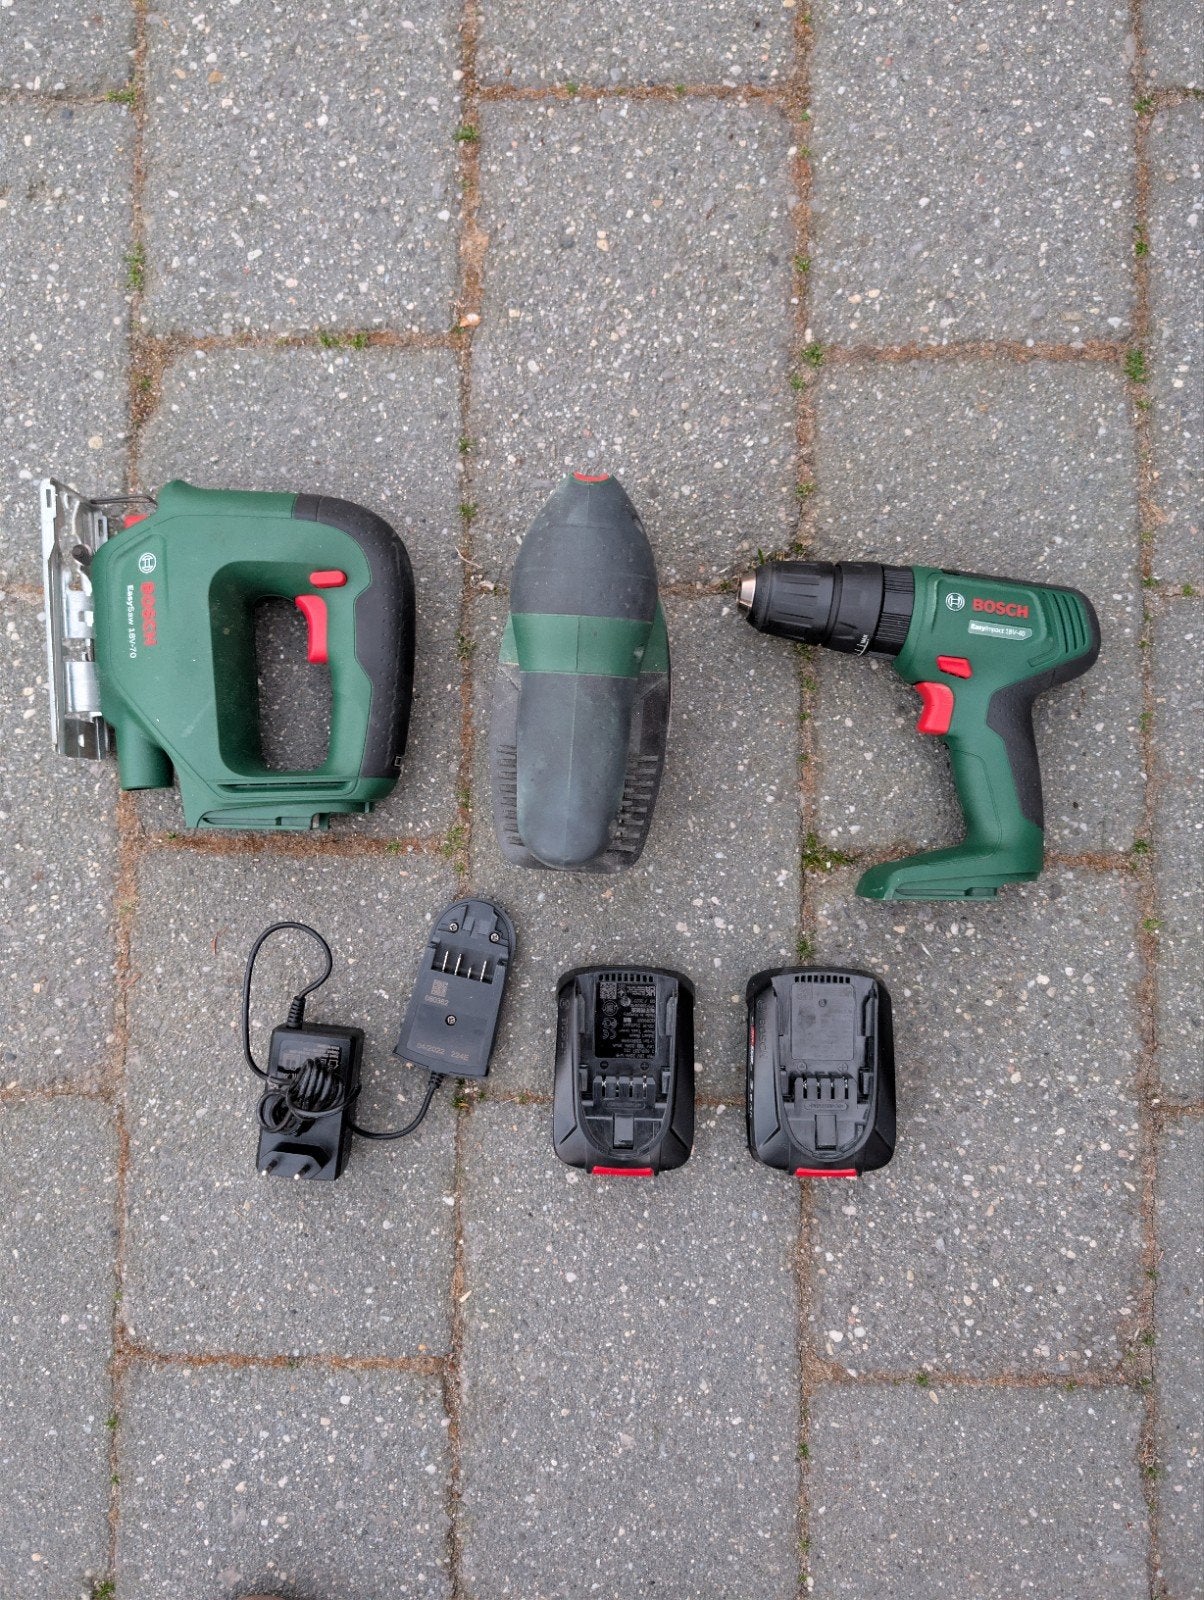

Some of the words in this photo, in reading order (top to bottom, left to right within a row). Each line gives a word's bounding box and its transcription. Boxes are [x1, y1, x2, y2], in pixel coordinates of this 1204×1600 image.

[126, 585, 134, 625] EasySaw
[140, 582, 157, 646] BOSCH
[972, 598, 1029, 618] BOSCH
[128, 628, 137, 659] 18V-70
[970, 623, 1004, 634] EasyImpact
